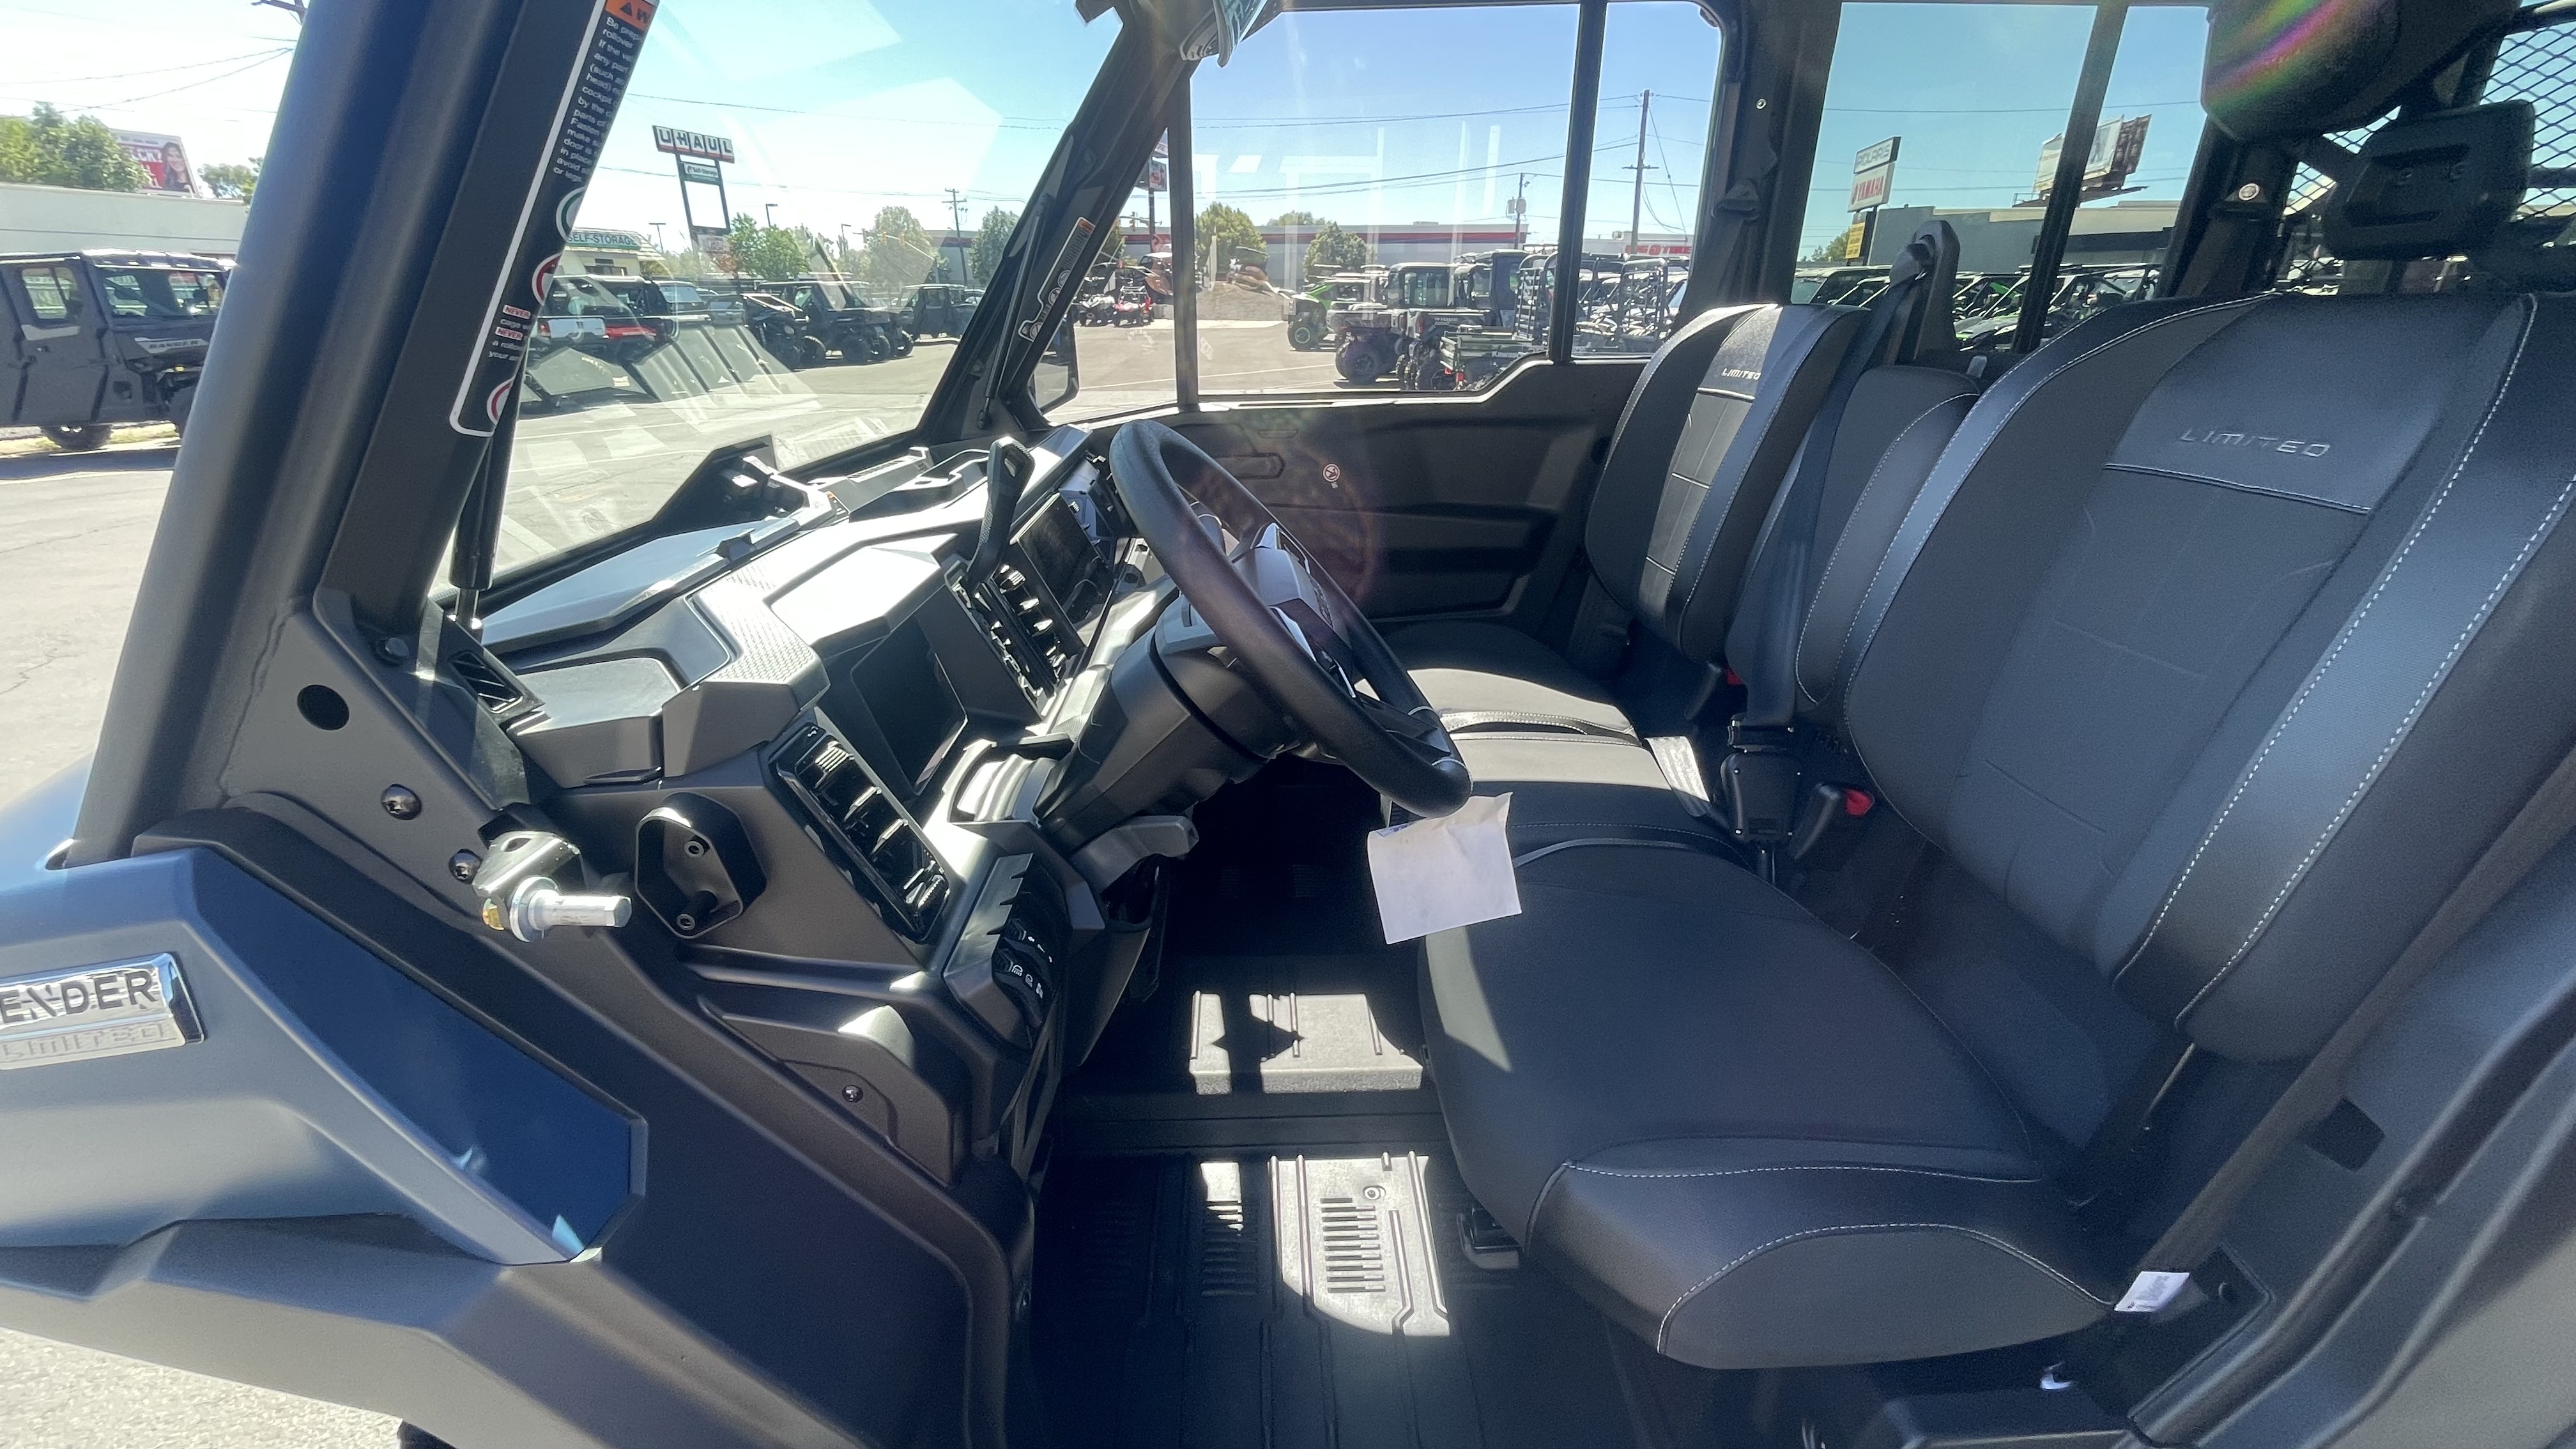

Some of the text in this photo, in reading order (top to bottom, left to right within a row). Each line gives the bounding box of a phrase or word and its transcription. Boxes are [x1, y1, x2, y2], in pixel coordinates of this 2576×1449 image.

[578, 96, 590, 108] by
[564, 137, 584, 150] door
[1857, 144, 1890, 165] POLARIS
[1857, 176, 1884, 201] YAMAHA
[505, 307, 530, 319] NEVER
[498, 328, 522, 339] NEVER
[1721, 368, 1761, 381] LIMITED
[2179, 429, 2331, 457] LIMITED
